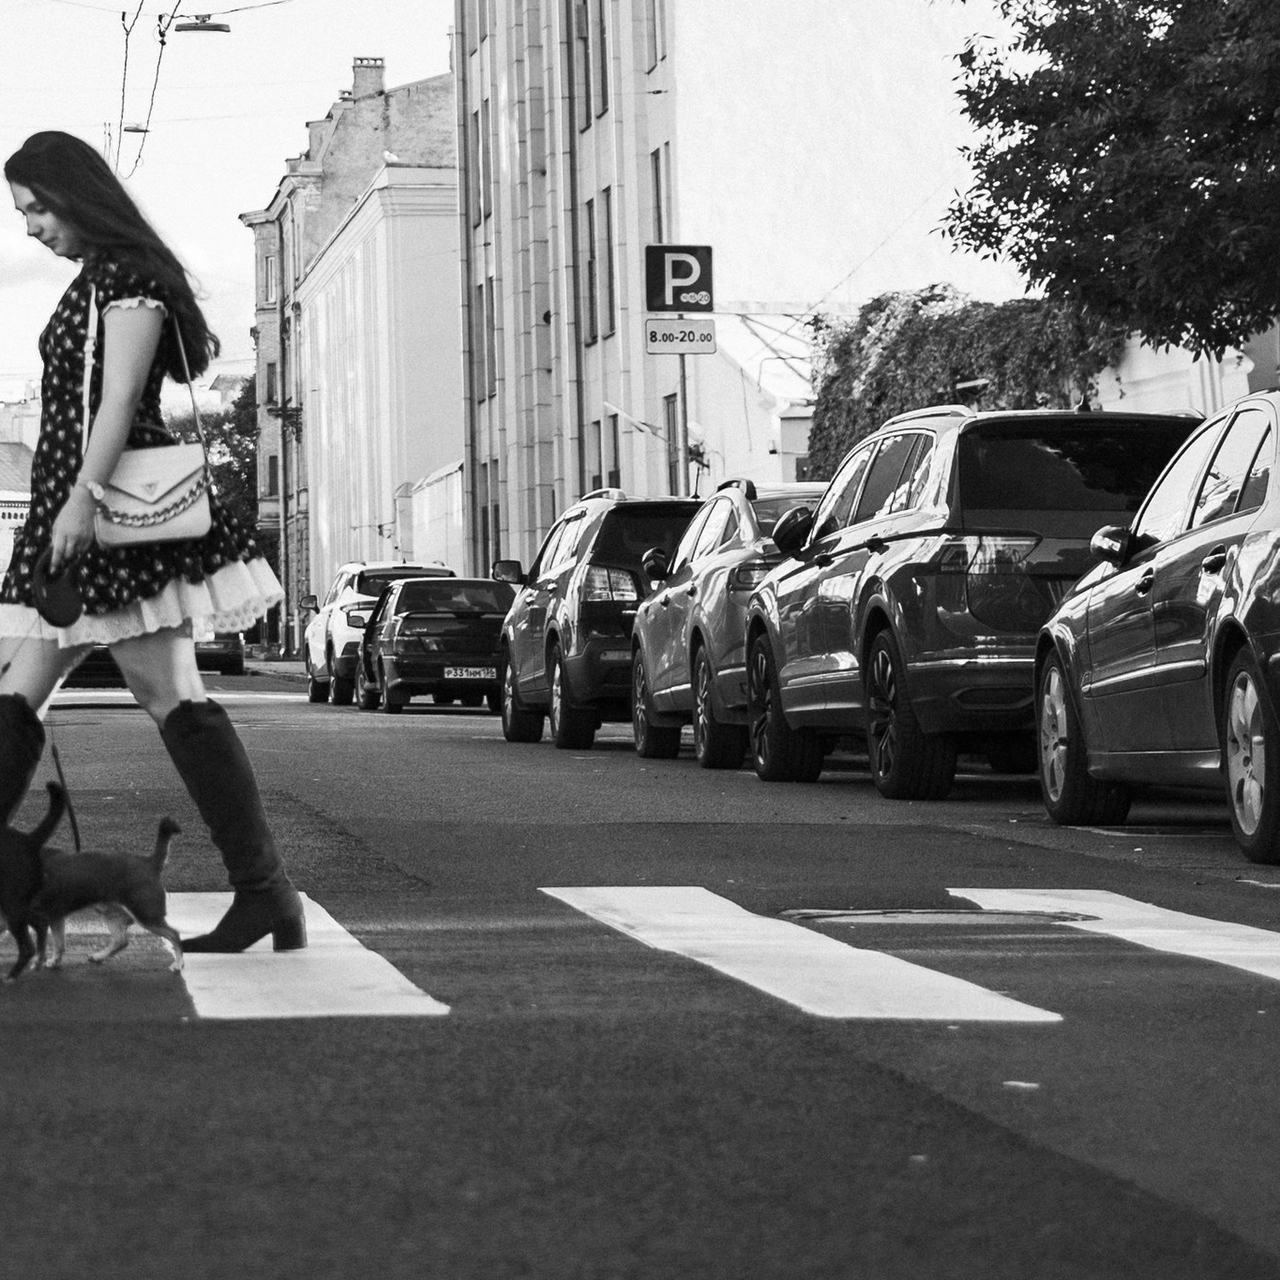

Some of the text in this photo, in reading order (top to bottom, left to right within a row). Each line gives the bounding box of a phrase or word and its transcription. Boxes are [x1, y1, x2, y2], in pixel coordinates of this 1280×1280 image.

[664, 252, 701, 305] P
[699, 293, 710, 302] 20
[649, 330, 713, 343] 8.00-20.00
